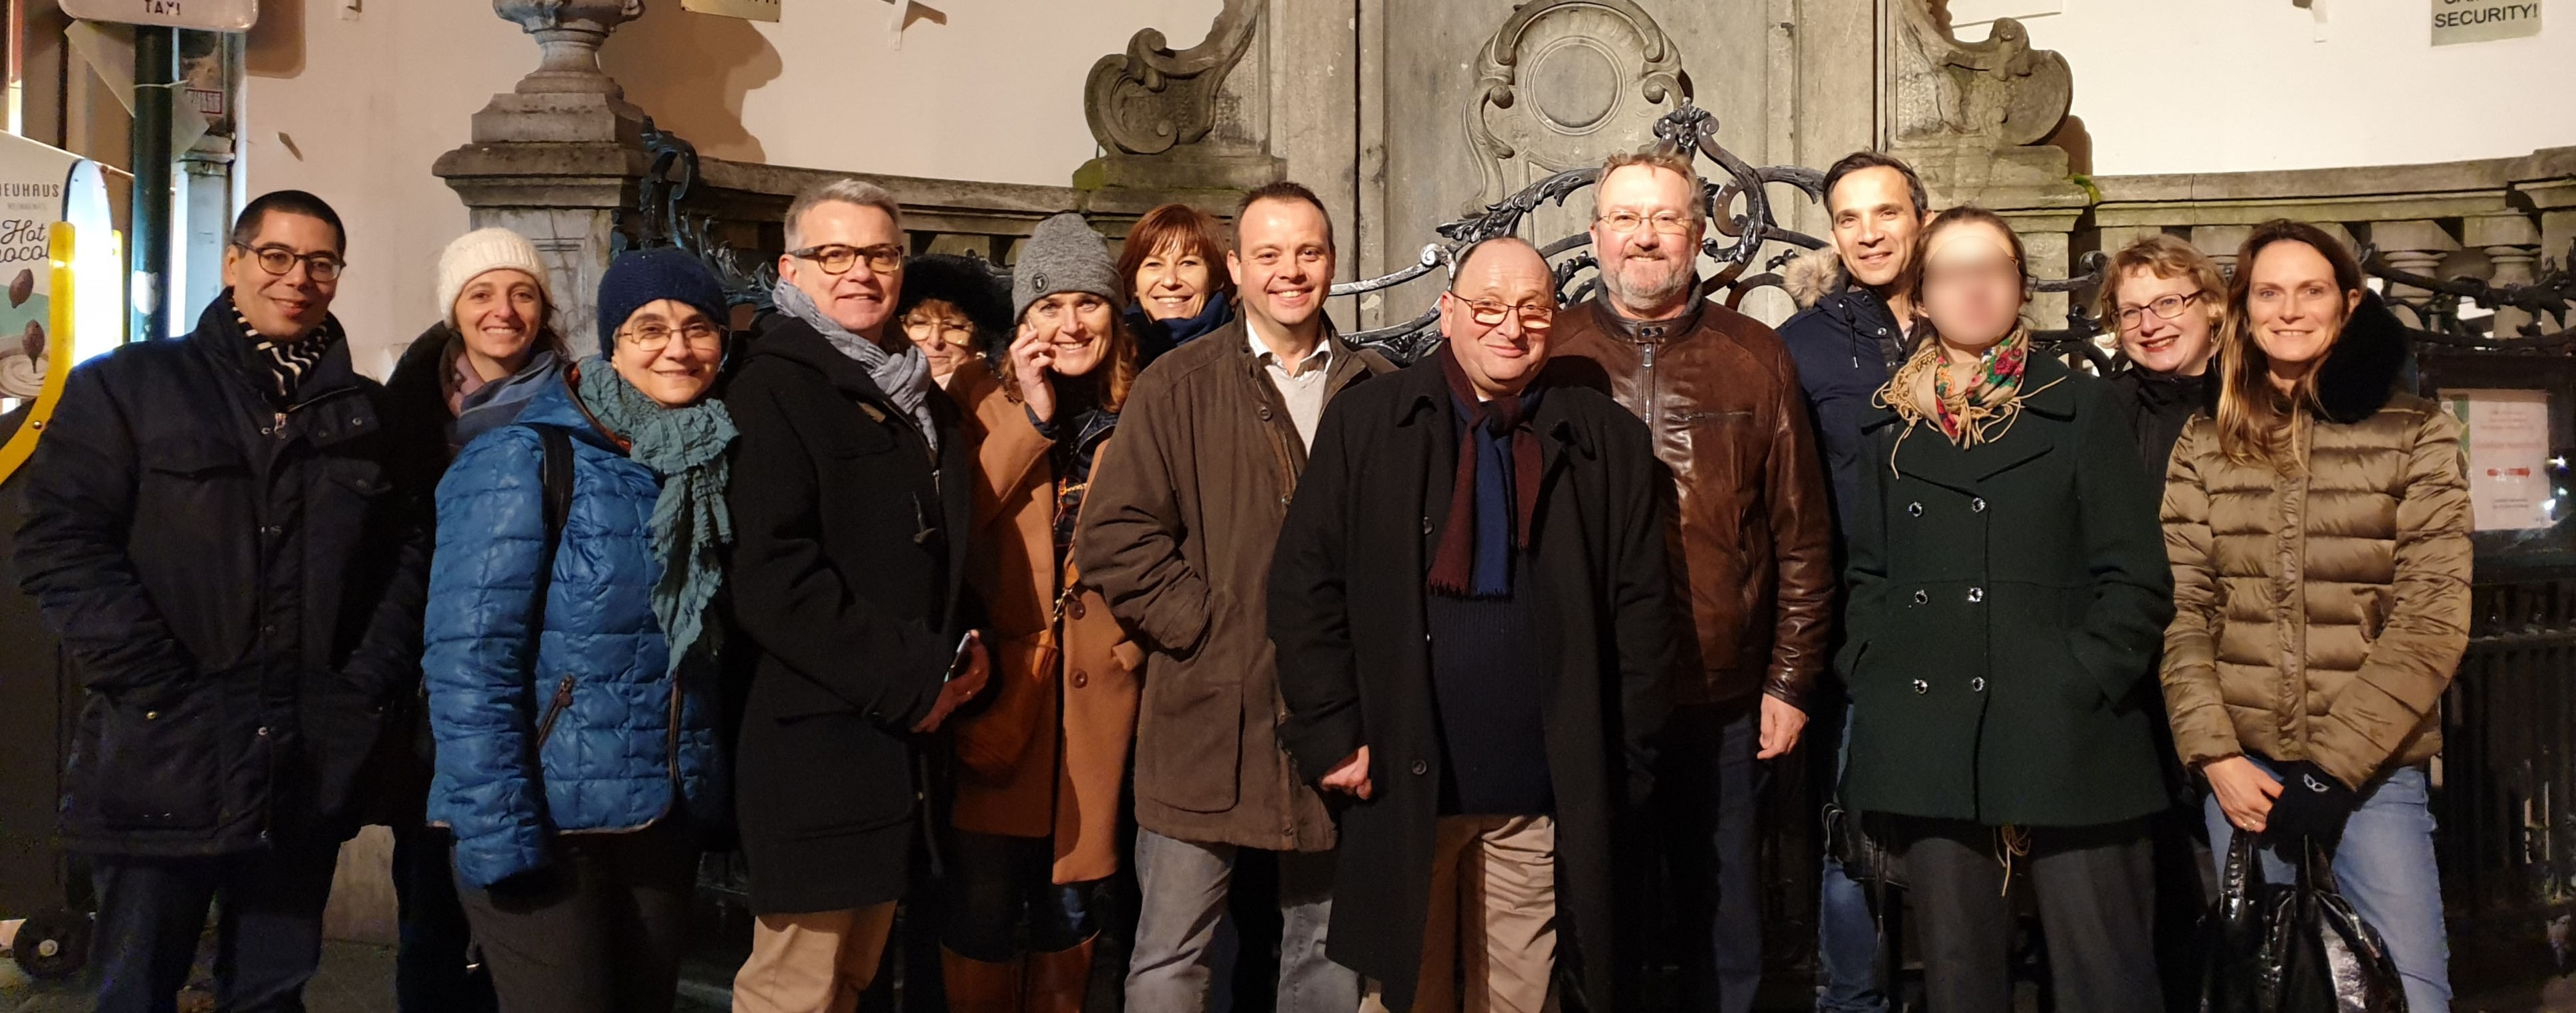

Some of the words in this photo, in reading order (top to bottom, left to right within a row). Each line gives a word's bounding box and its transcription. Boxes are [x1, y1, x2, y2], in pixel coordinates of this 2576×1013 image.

[144, 0, 180, 15] TAXI
[2434, 3, 2537, 28] SECURITY!
[0, 183, 59, 197] EUHAUS
[0, 219, 46, 245] Hot
